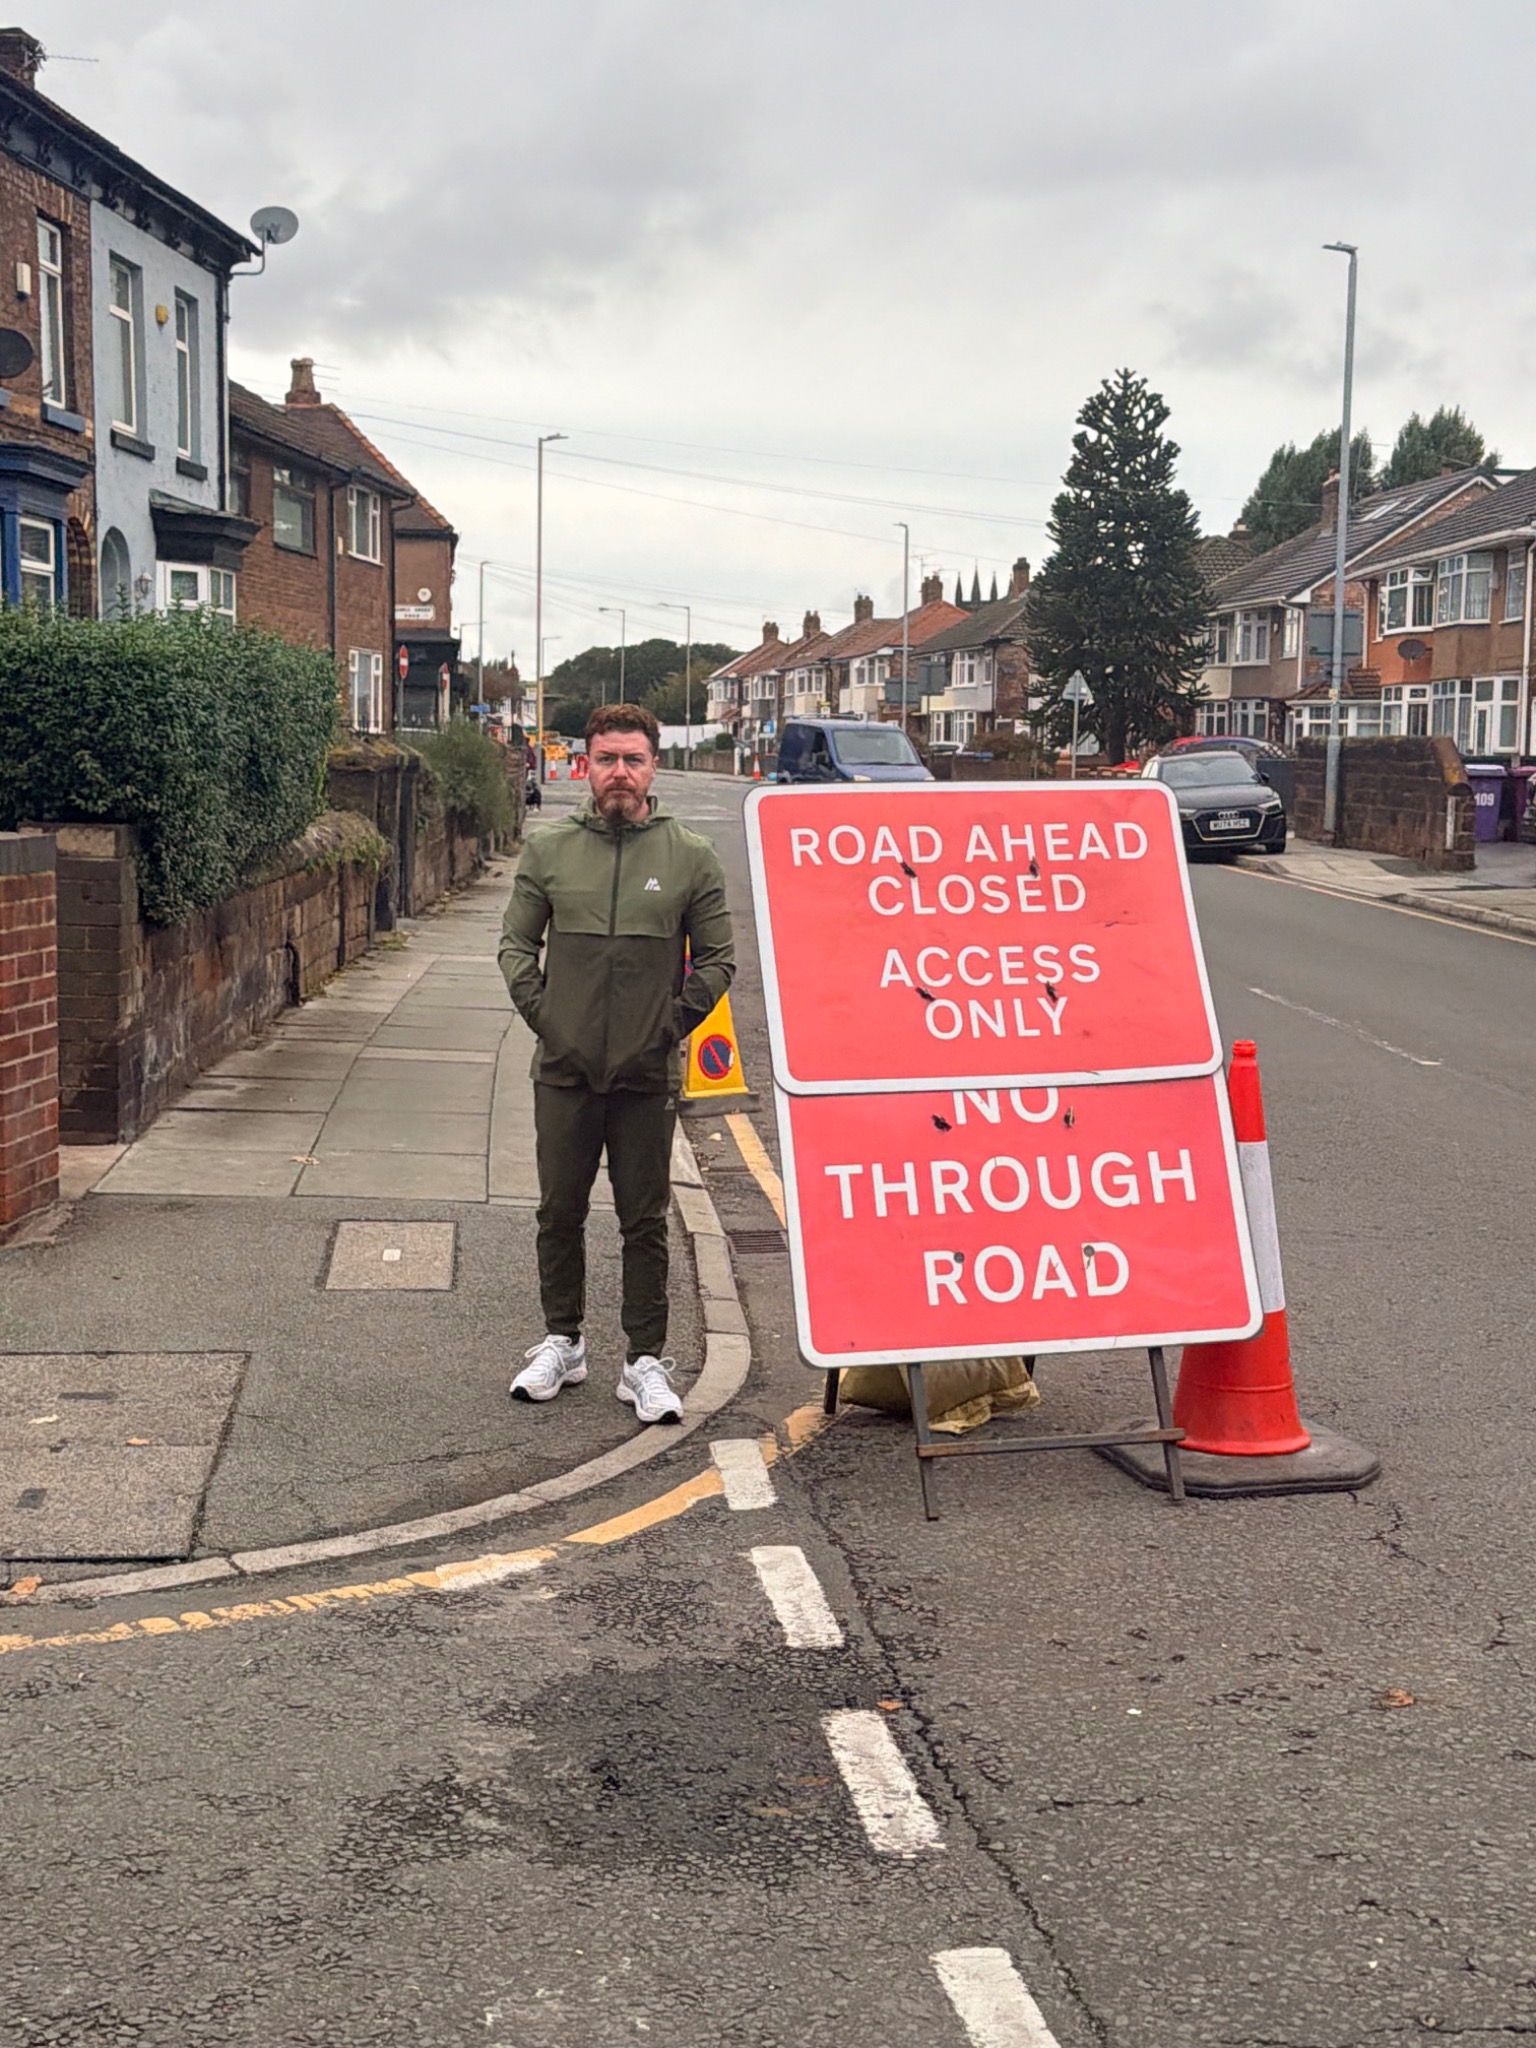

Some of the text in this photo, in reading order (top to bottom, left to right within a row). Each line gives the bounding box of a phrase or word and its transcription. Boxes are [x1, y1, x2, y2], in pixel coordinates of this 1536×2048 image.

[1474, 793, 1495, 806] 109
[790, 822, 1148, 866] ROAD AHEAD
[868, 874, 1086, 916] CLOSED
[880, 943, 1101, 988] ACCESS
[925, 996, 1068, 1040] ONLY
[952, 1087, 1059, 1125] NO
[824, 1149, 1196, 1219] THROUGH
[923, 1241, 1130, 1306] ROAD
